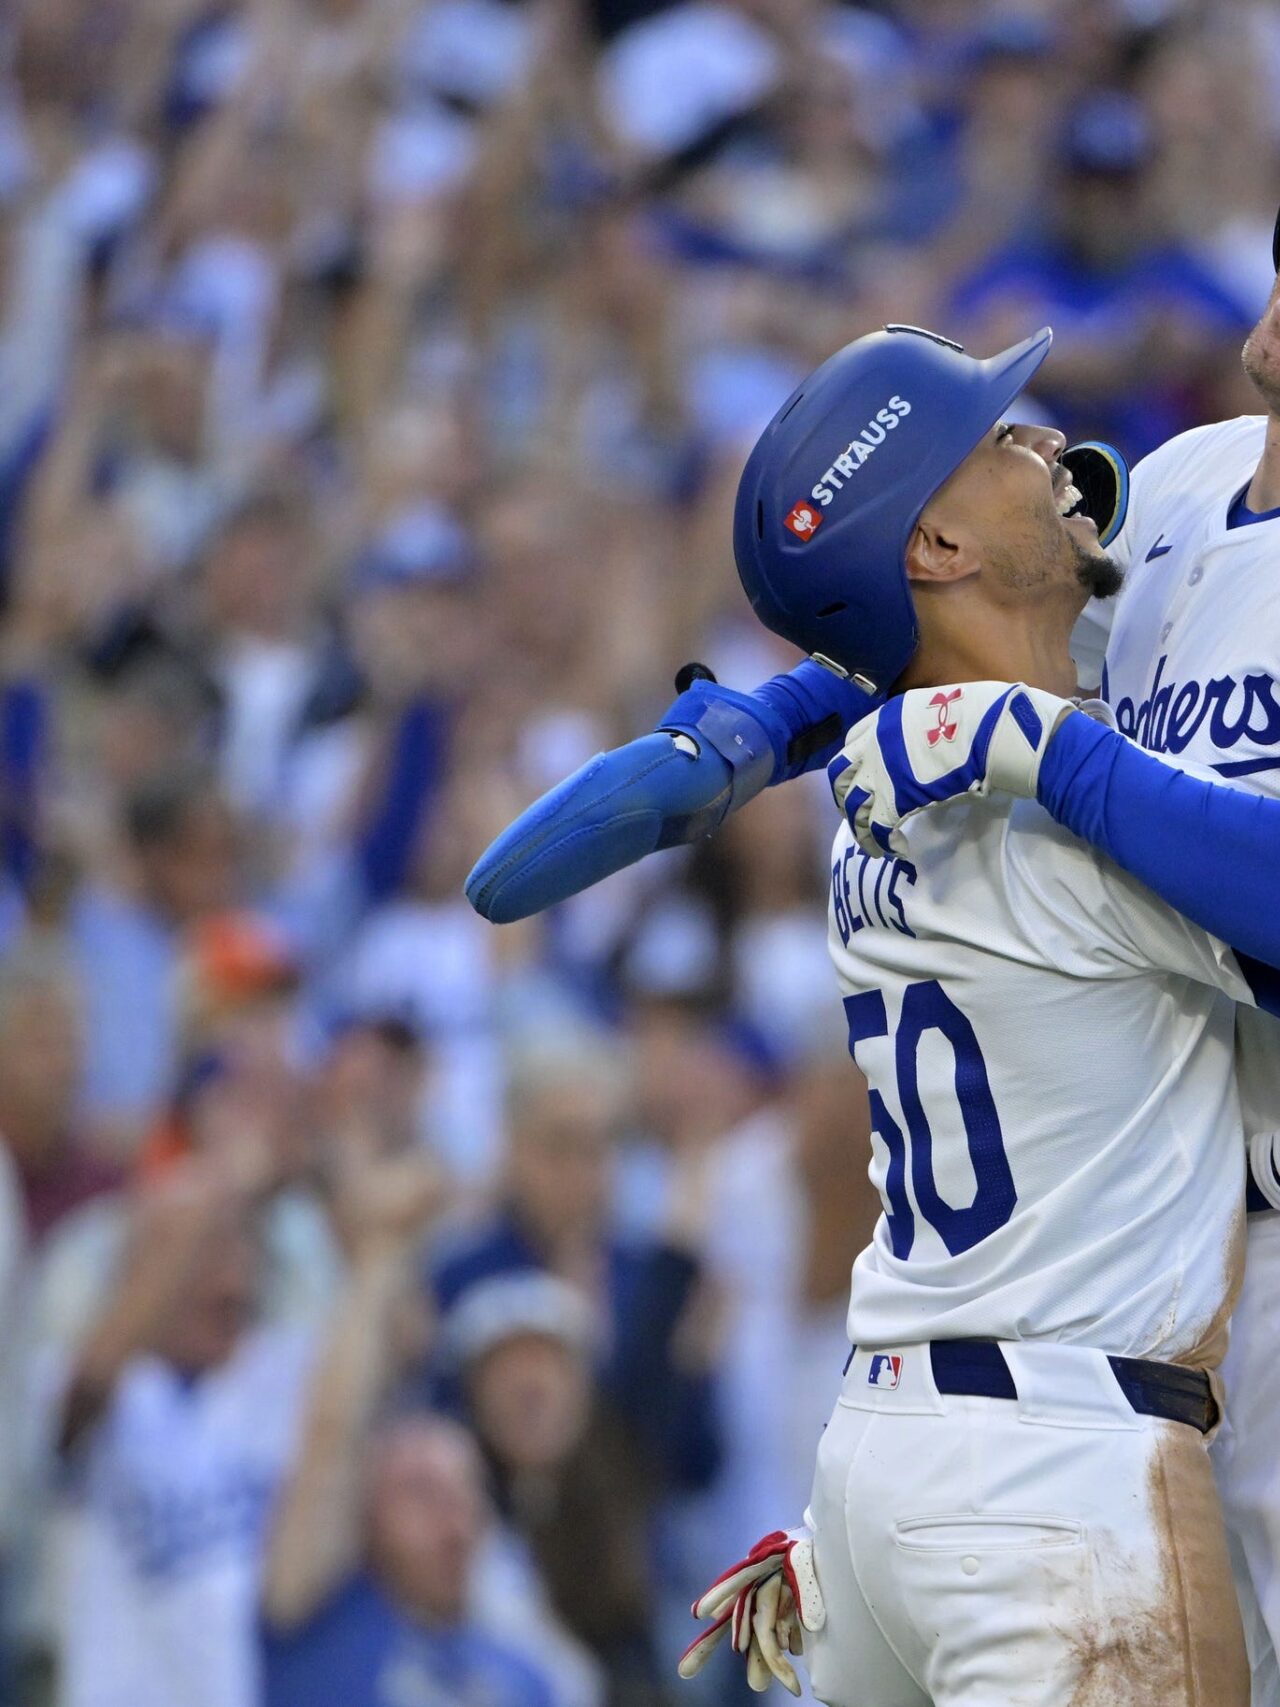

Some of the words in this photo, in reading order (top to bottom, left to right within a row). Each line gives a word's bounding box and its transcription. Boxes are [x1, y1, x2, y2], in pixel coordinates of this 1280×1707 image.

[811, 395, 912, 506] STRAUSS
[832, 846, 917, 949] BETTS
[842, 979, 1018, 1262] 50
